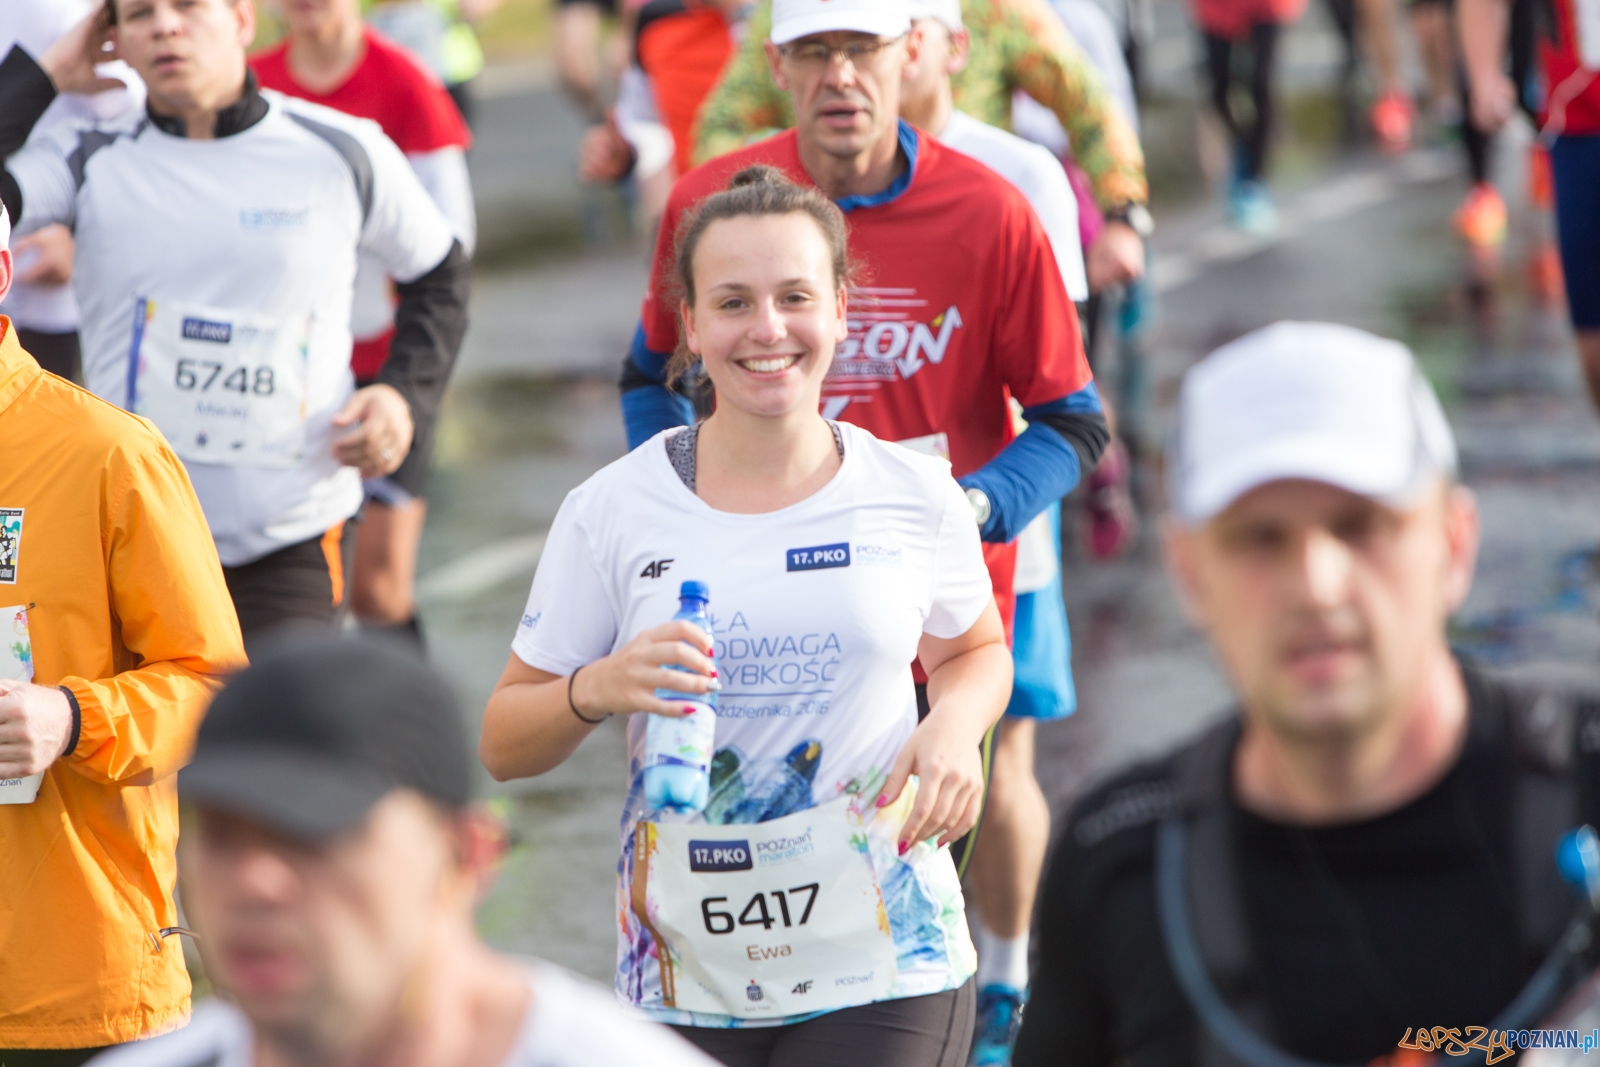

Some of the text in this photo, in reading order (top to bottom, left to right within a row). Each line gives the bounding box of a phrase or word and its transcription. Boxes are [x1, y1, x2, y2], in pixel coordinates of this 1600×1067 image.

[176, 358, 275, 396] 6748
[640, 558, 675, 579] 4F
[711, 611, 750, 633] ŁA
[721, 656, 840, 686] YBKOŚĆ
[717, 699, 831, 719] ździernika 2016
[0, 777, 22, 786] Znań
[758, 842, 816, 863] maraton
[701, 882, 819, 935] 6417
[746, 944, 792, 961] Ewa
[791, 980, 814, 995] 4F
